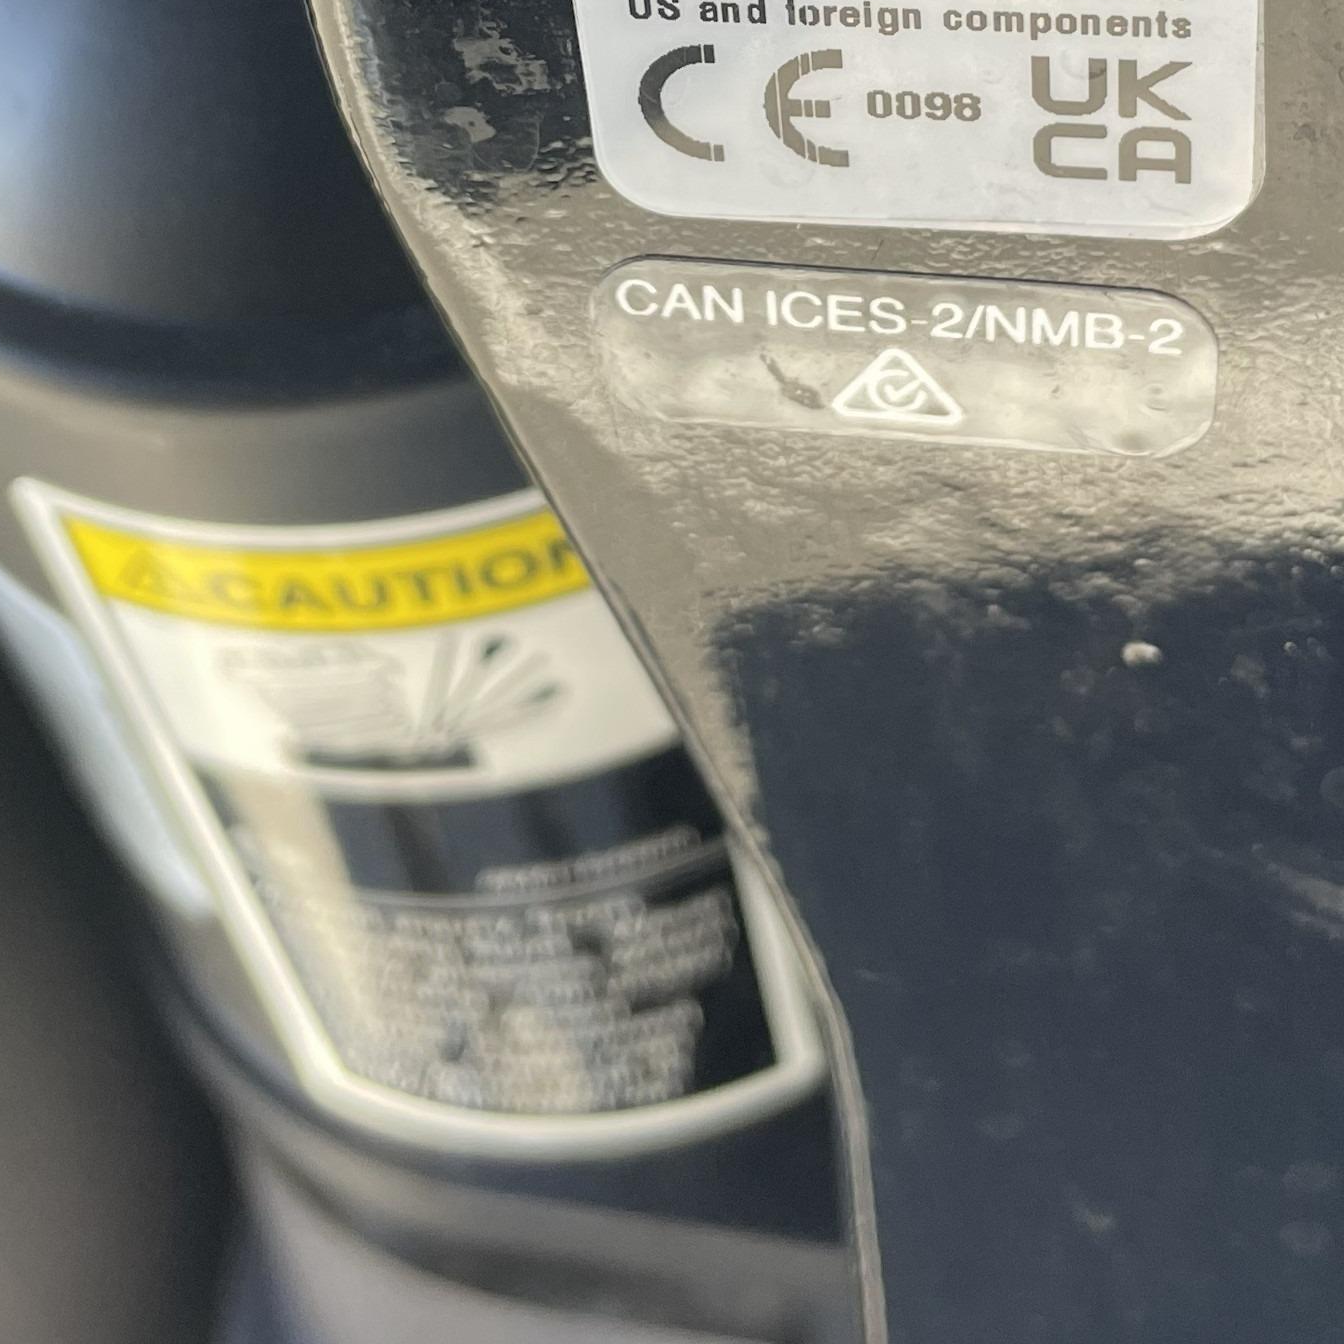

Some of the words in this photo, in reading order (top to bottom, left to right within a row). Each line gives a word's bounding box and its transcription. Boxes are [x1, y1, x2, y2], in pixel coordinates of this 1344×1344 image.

[943, 6, 1192, 41] components
[638, 44, 851, 168] CE
[866, 89, 982, 123] 0098
[1031, 55, 1193, 122] UK
[1032, 125, 1193, 185] CA
[616, 278, 745, 326] CAN
[765, 290, 1184, 356] ICES-2/NMB-2
